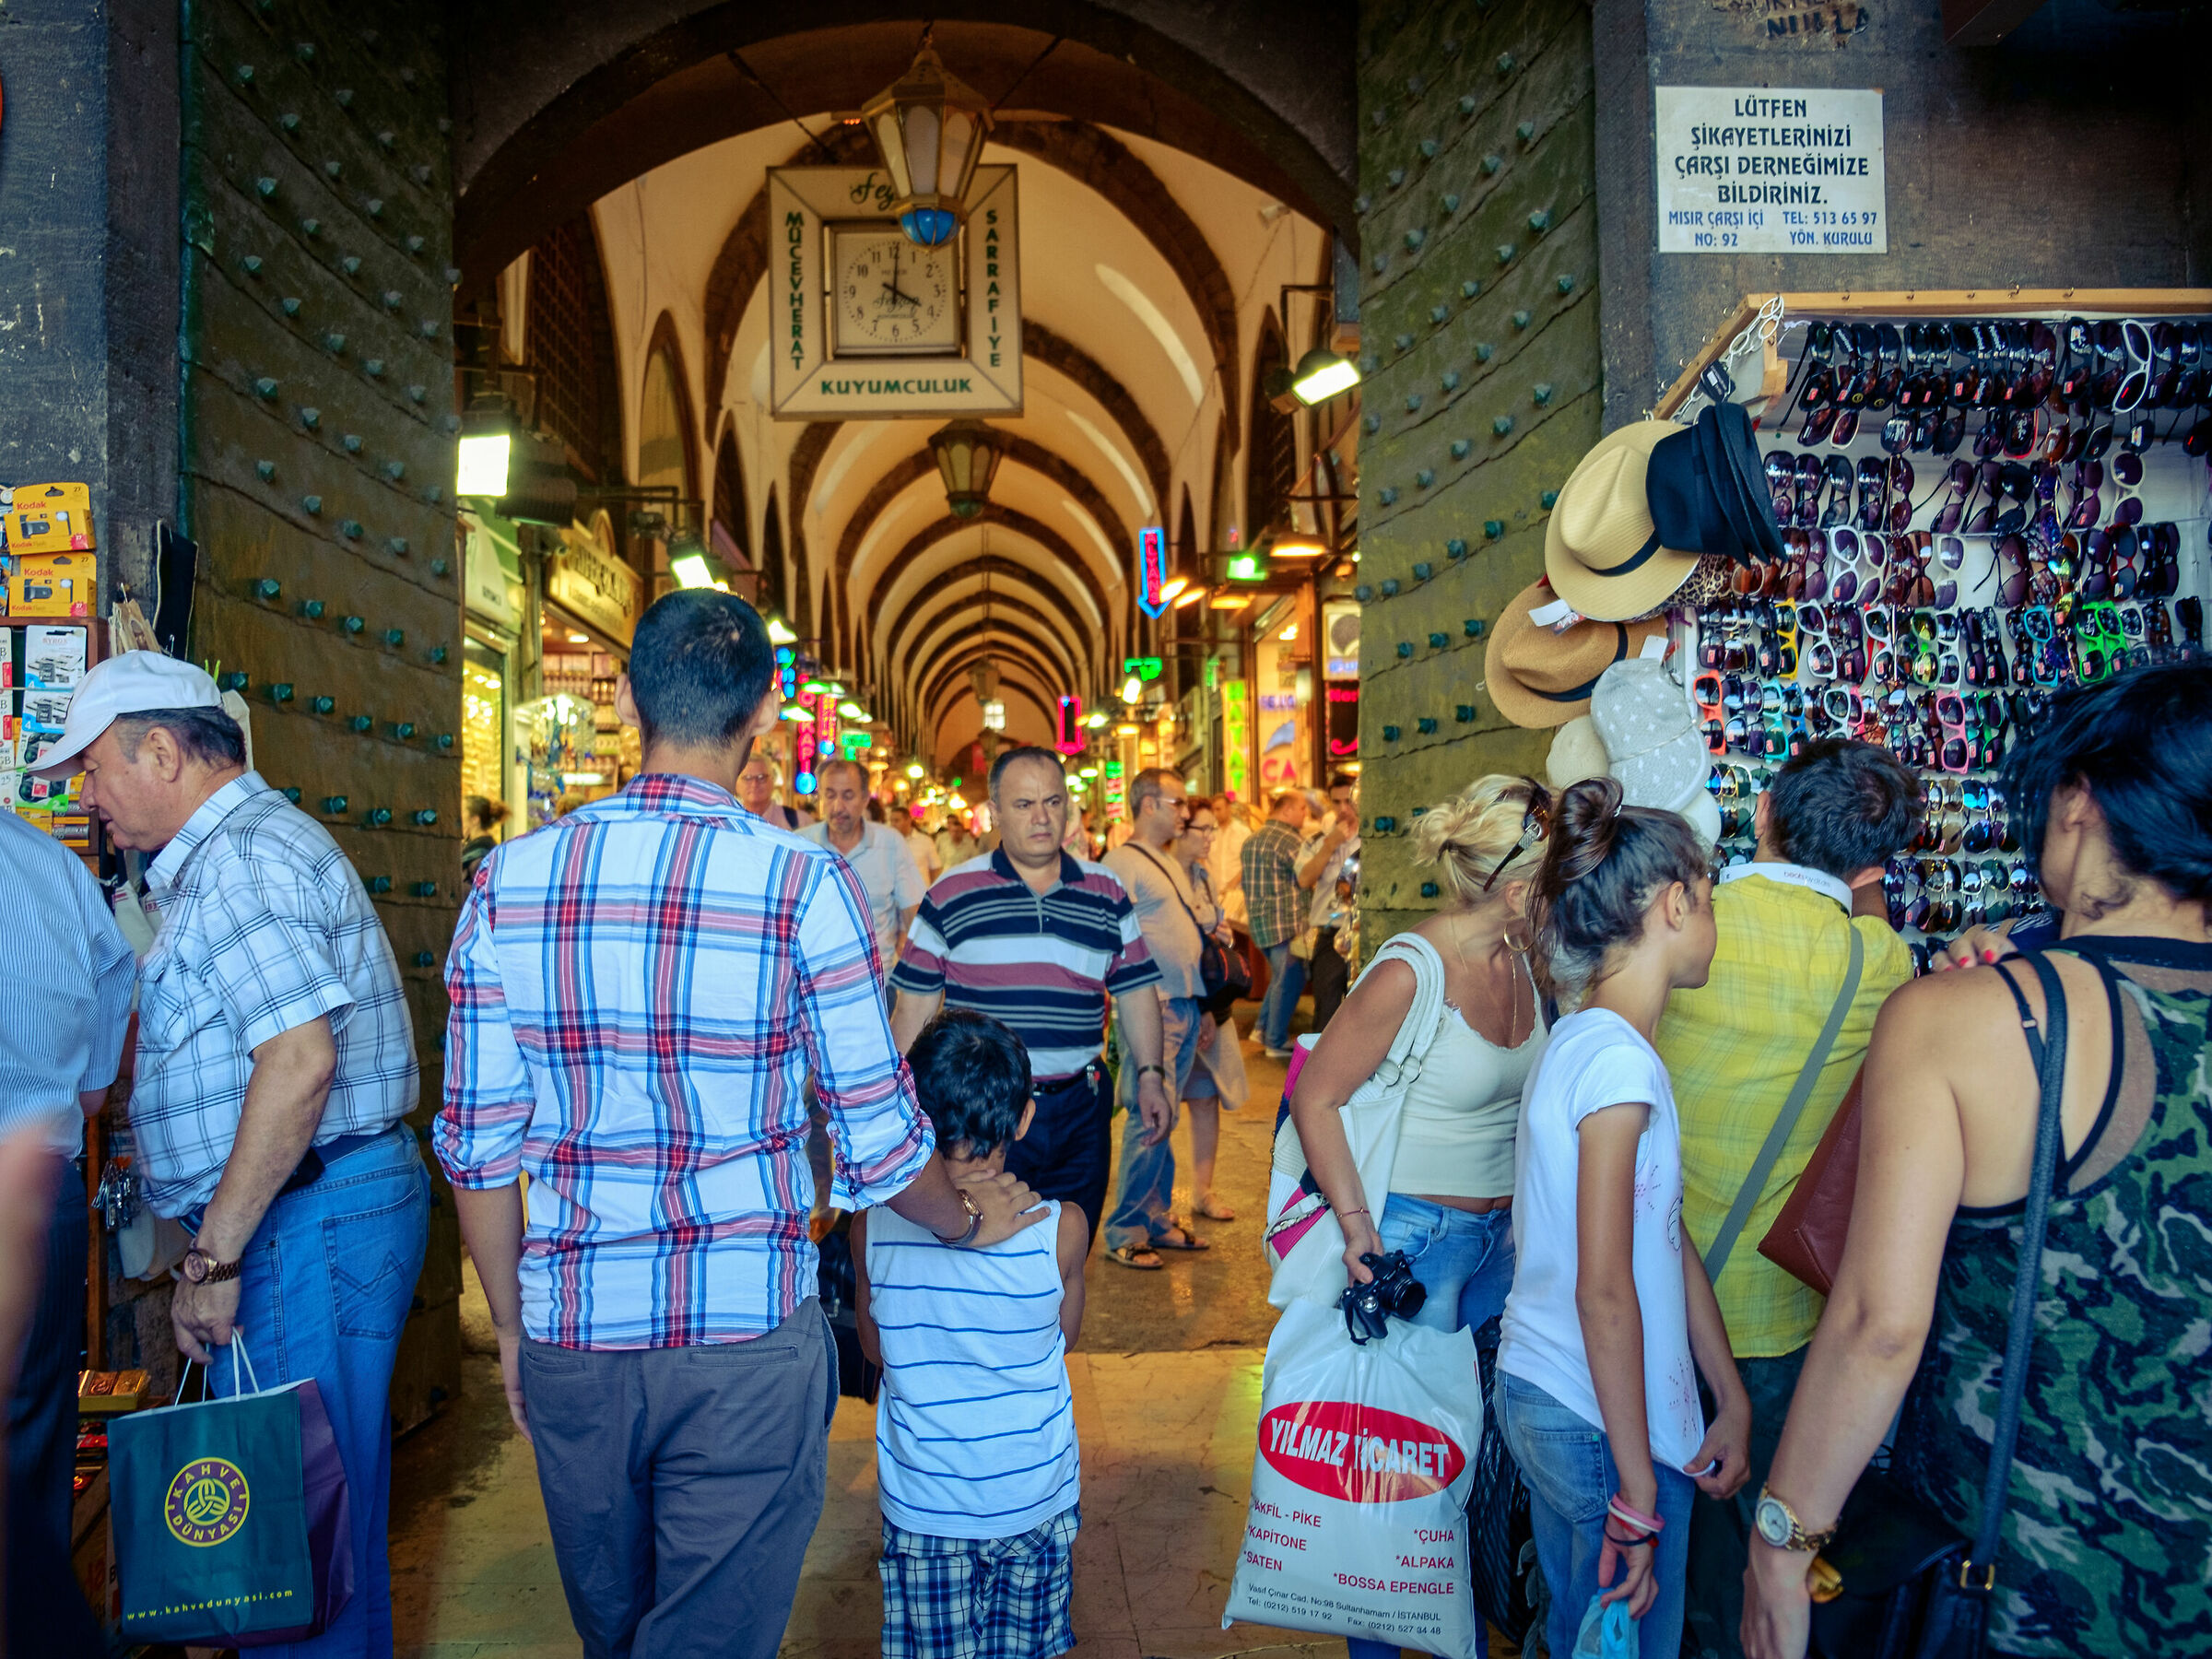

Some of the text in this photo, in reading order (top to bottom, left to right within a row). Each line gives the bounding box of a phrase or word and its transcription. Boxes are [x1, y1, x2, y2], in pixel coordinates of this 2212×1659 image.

[1735, 95, 1806, 119] LÜTFEN
[1691, 123, 1851, 150] ŞİKAYETLERİNİZİ
[1675, 152, 1868, 180] ÇARŞI DERNEĞİMİZE
[1718, 182, 1828, 205] BİLDİRİNİZ.
[1668, 208, 1763, 230] MISIR ÇARŞI İÇİ
[1783, 211, 1877, 226] TEL: 513 65 97
[1695, 233, 1738, 247] NO: 92
[1789, 229, 1873, 245] YÖN. KURULU
[820, 379, 973, 396] KUYUMCULUK
[17, 501, 46, 510] Kodak
[1270, 1418, 1449, 1477] YILMAZ TİCARET
[172, 1464, 241, 1499] KAHVE
[172, 1506, 242, 1540] DÜNYASI
[1292, 1510, 1321, 1528] PİKE
[1249, 1525, 1307, 1551] KAPİTONE
[1418, 1529, 1454, 1544] ÇUHA
[1246, 1551, 1282, 1571] SATEN
[1401, 1555, 1454, 1569] ALPAKA
[1338, 1573, 1454, 1594] BOSSA EPENGLE
[127, 1589, 293, 1620] www.kahvedunyasi.com
[1264, 1600, 1288, 1614] (0212)
[1310, 1609, 1319, 1618] 17
[1322, 1612, 1332, 1620] 92
[1335, 1602, 1390, 1618] Sultanhamam
[1397, 1609, 1441, 1621] İSTANBUL
[1368, 1621, 1394, 1632] (0212)
